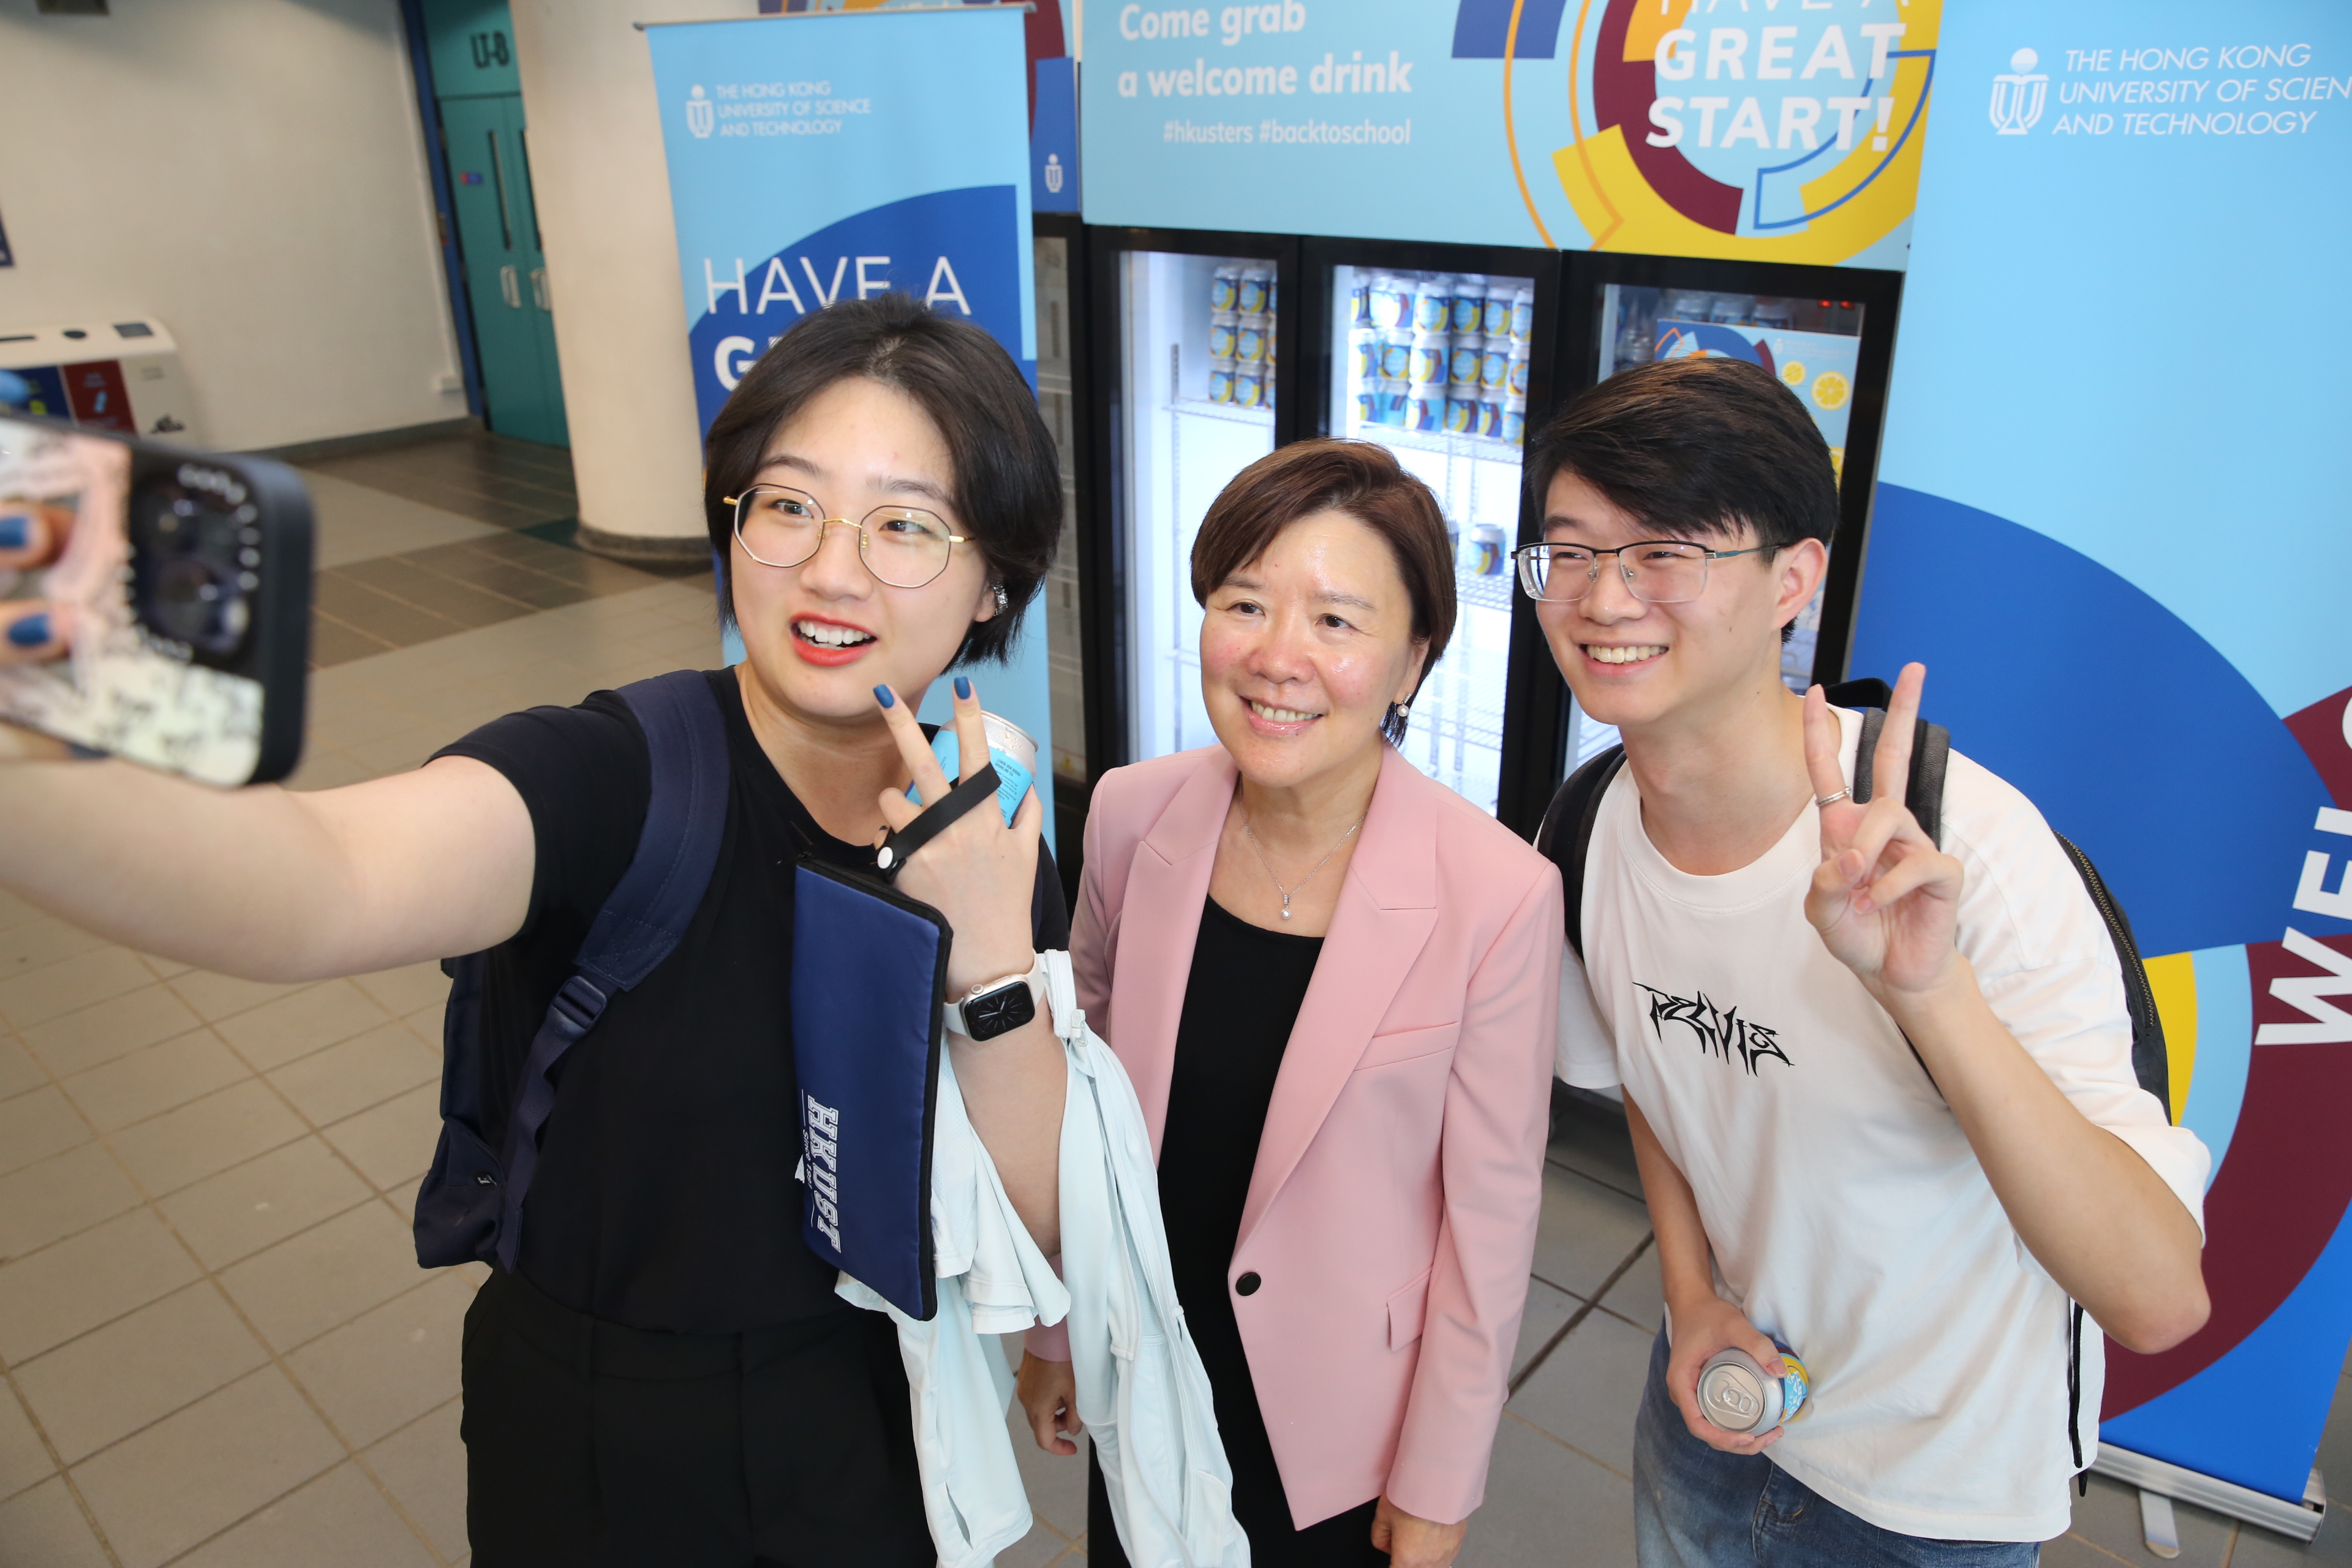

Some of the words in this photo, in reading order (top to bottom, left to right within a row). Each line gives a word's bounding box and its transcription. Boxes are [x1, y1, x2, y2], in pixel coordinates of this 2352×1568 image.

[1120, 4, 1210, 40] Come
[1221, 0, 1306, 46] grab
[1654, 22, 1907, 81] GREAT
[2066, 49, 2113, 71] THE
[2119, 47, 2209, 71] HONG
[2218, 43, 2311, 69] KONG
[716, 83, 739, 99] THE
[742, 82, 786, 99] HONG
[788, 80, 831, 96] KONG
[1118, 71, 1138, 97] a
[1147, 58, 1298, 96] welcome
[1310, 50, 1414, 94] drink
[2059, 80, 2211, 104] UNIVERSITY
[2217, 79, 2258, 102] OF
[2264, 76, 2352, 102] SCIEN
[718, 101, 790, 118] UNIVERSITY
[792, 100, 811, 116] OF
[815, 98, 870, 115] SCIENCE
[1645, 94, 1896, 153] START!
[2052, 113, 2114, 135] AND
[2122, 111, 2318, 135] TECHNOLOGY
[720, 122, 750, 137] AND
[752, 118, 842, 136] TECHNOLOGY
[1164, 120, 1254, 143] #hkusters
[1259, 118, 1411, 145] #backtoschool
[704, 256, 891, 315] HAVE
[925, 256, 972, 315] A
[714, 335, 784, 393] G
[802, 1129, 811, 1161] Since
[807, 1095, 842, 1253] HKUST
